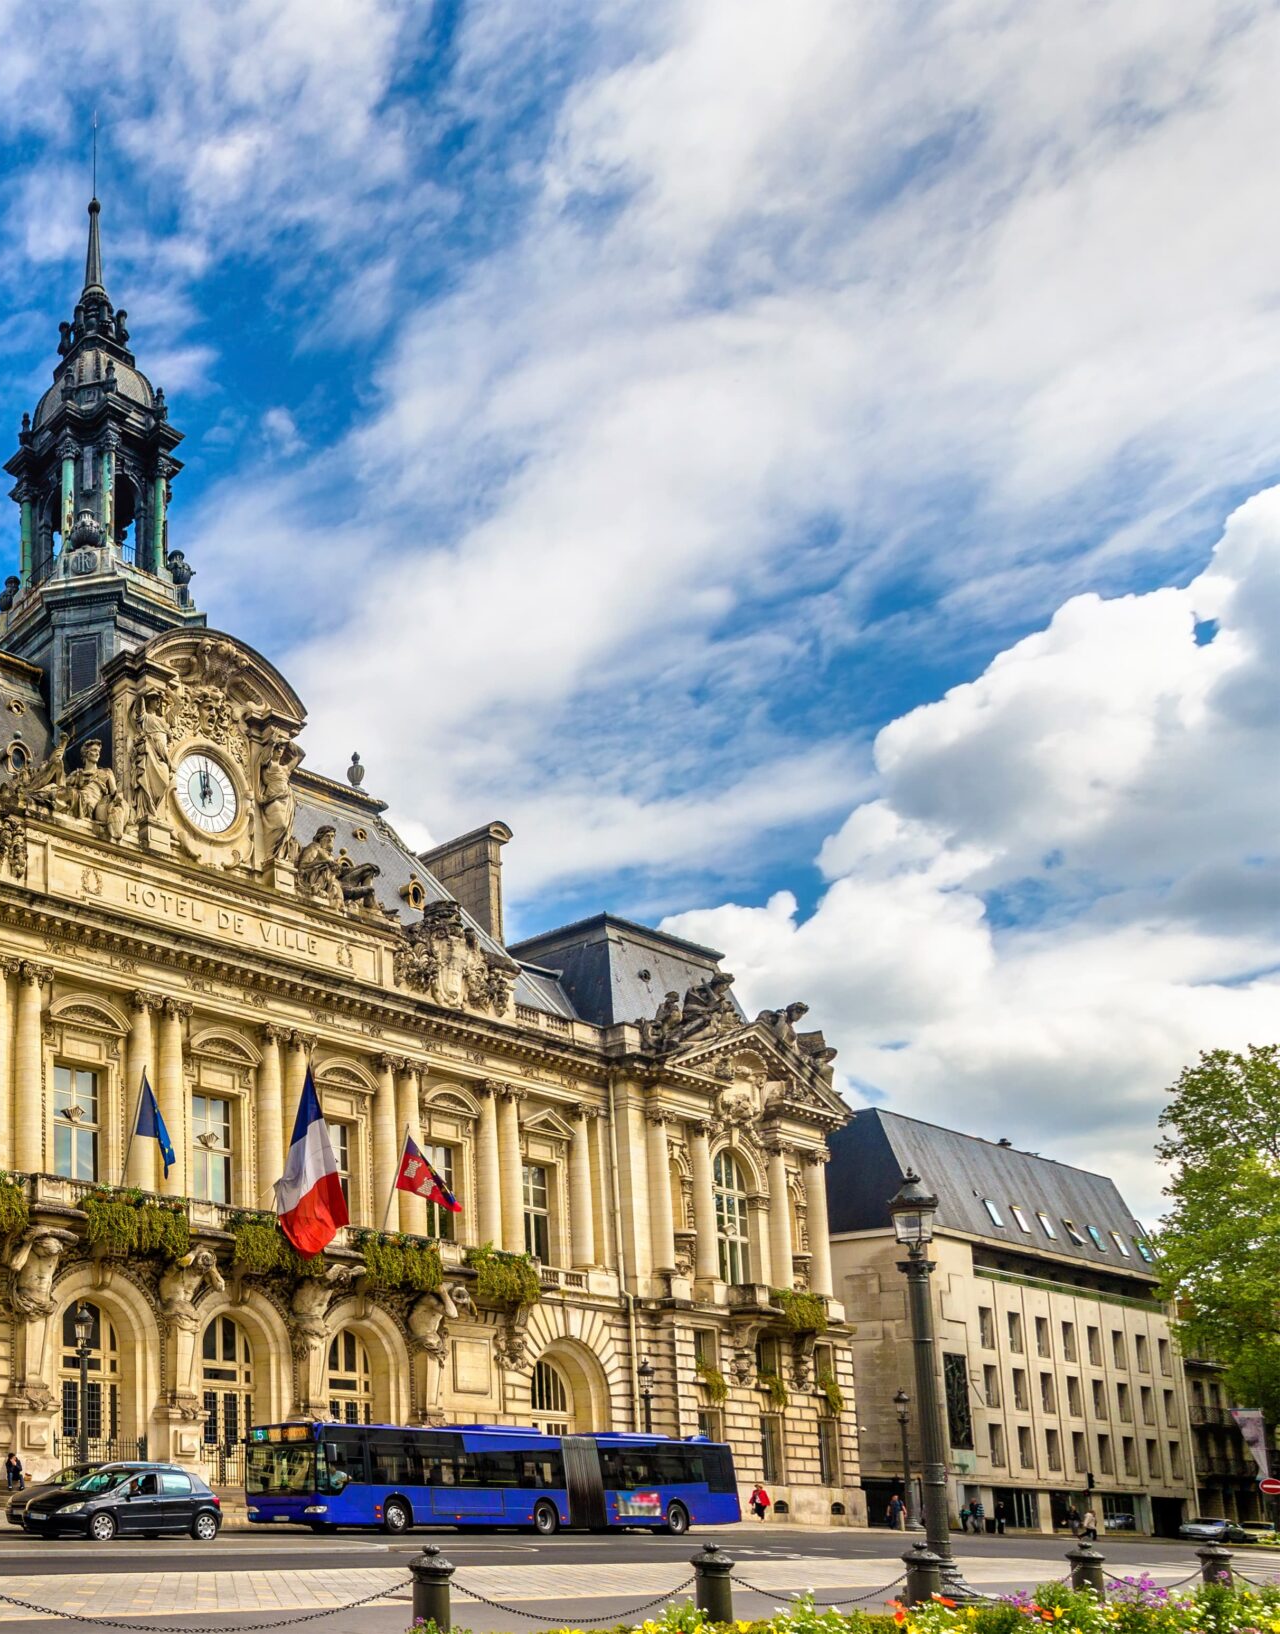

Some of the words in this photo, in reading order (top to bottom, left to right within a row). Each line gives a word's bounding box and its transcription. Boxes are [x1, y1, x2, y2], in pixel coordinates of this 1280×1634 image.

[125, 882, 203, 923] HOTEL
[217, 909, 245, 935] DE
[259, 922, 318, 956] VILLE
[257, 1430, 264, 1440] 5
